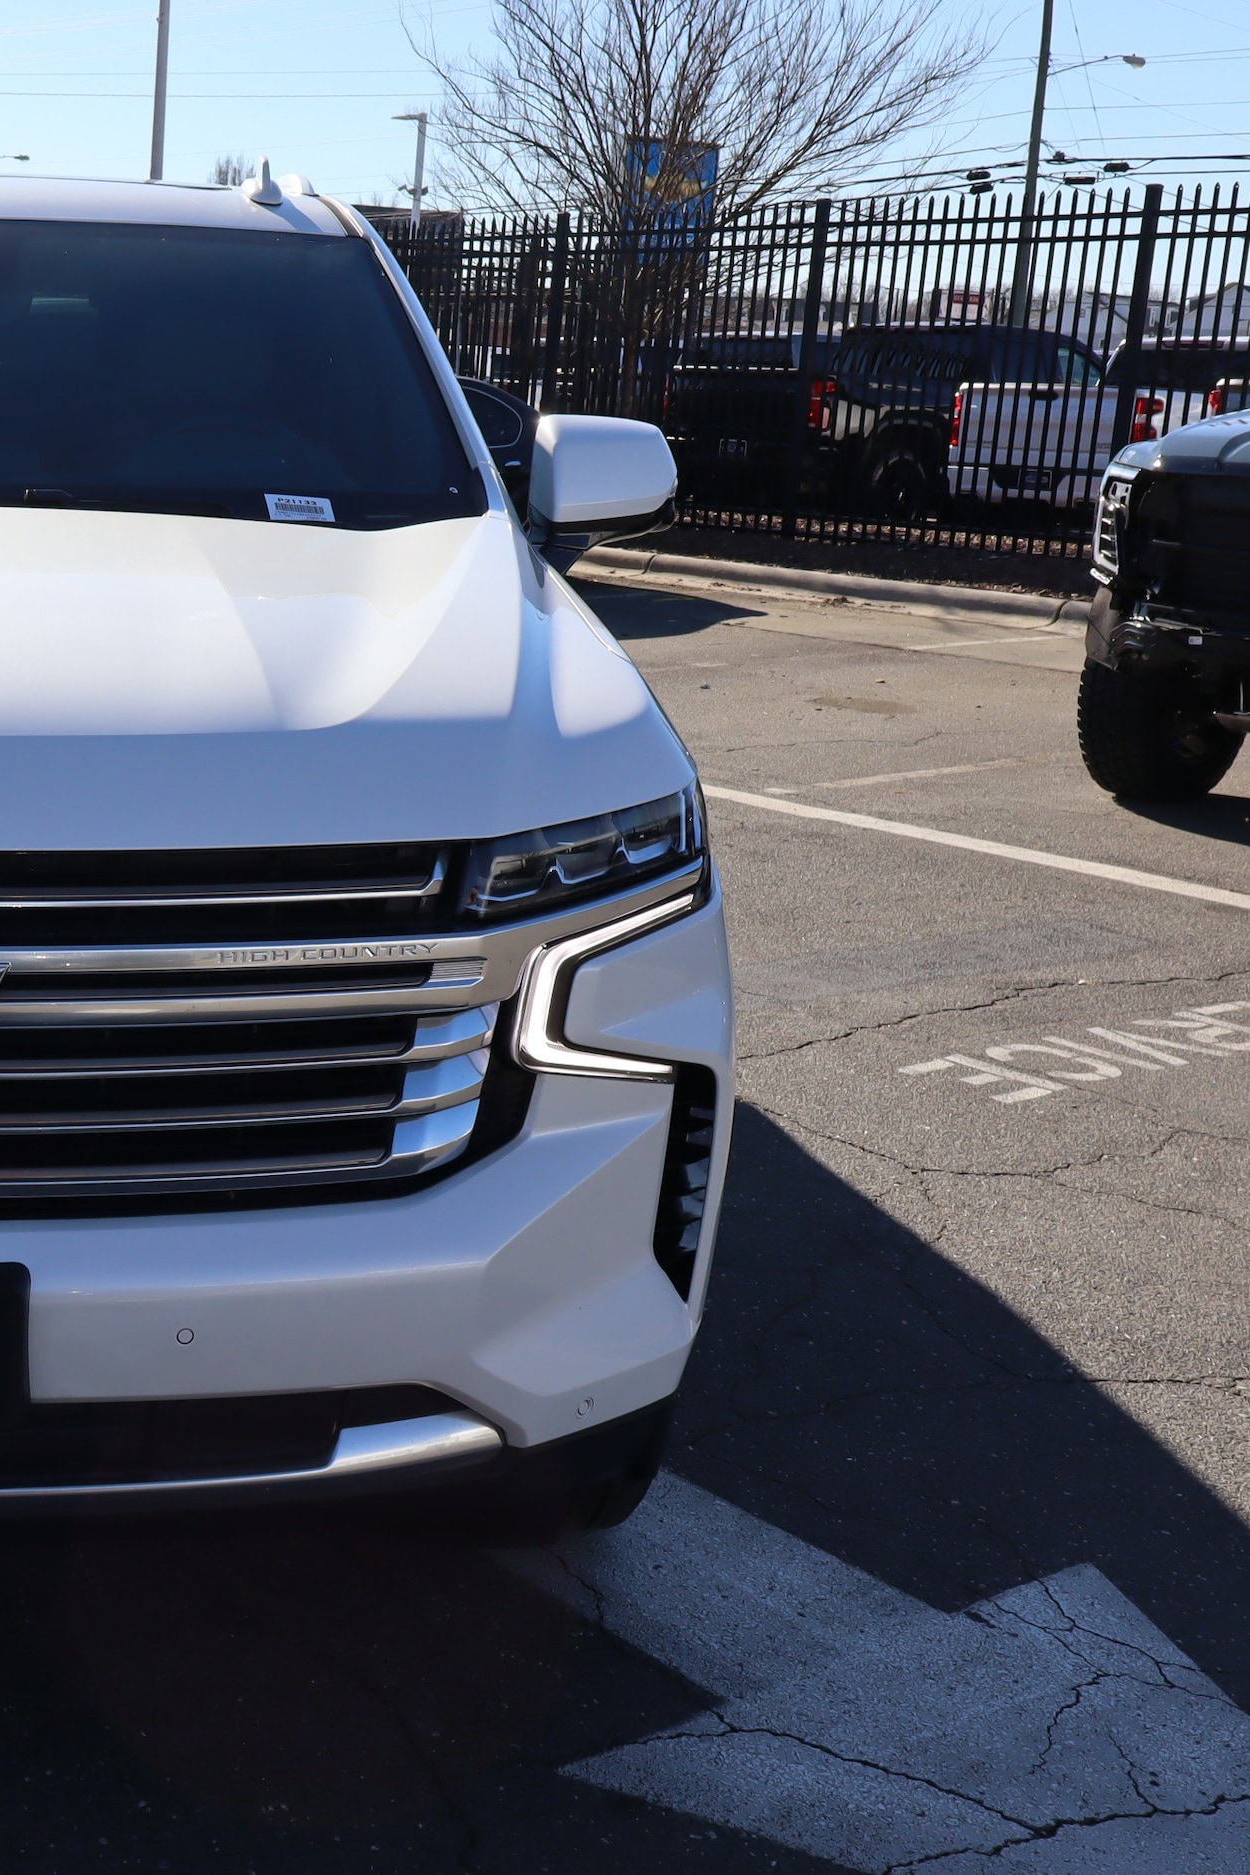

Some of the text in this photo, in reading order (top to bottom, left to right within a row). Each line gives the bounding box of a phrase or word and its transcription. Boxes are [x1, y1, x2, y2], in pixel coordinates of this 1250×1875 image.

[277, 497, 318, 506] P21133
[217, 942, 439, 964] HIGH COUNTRY
